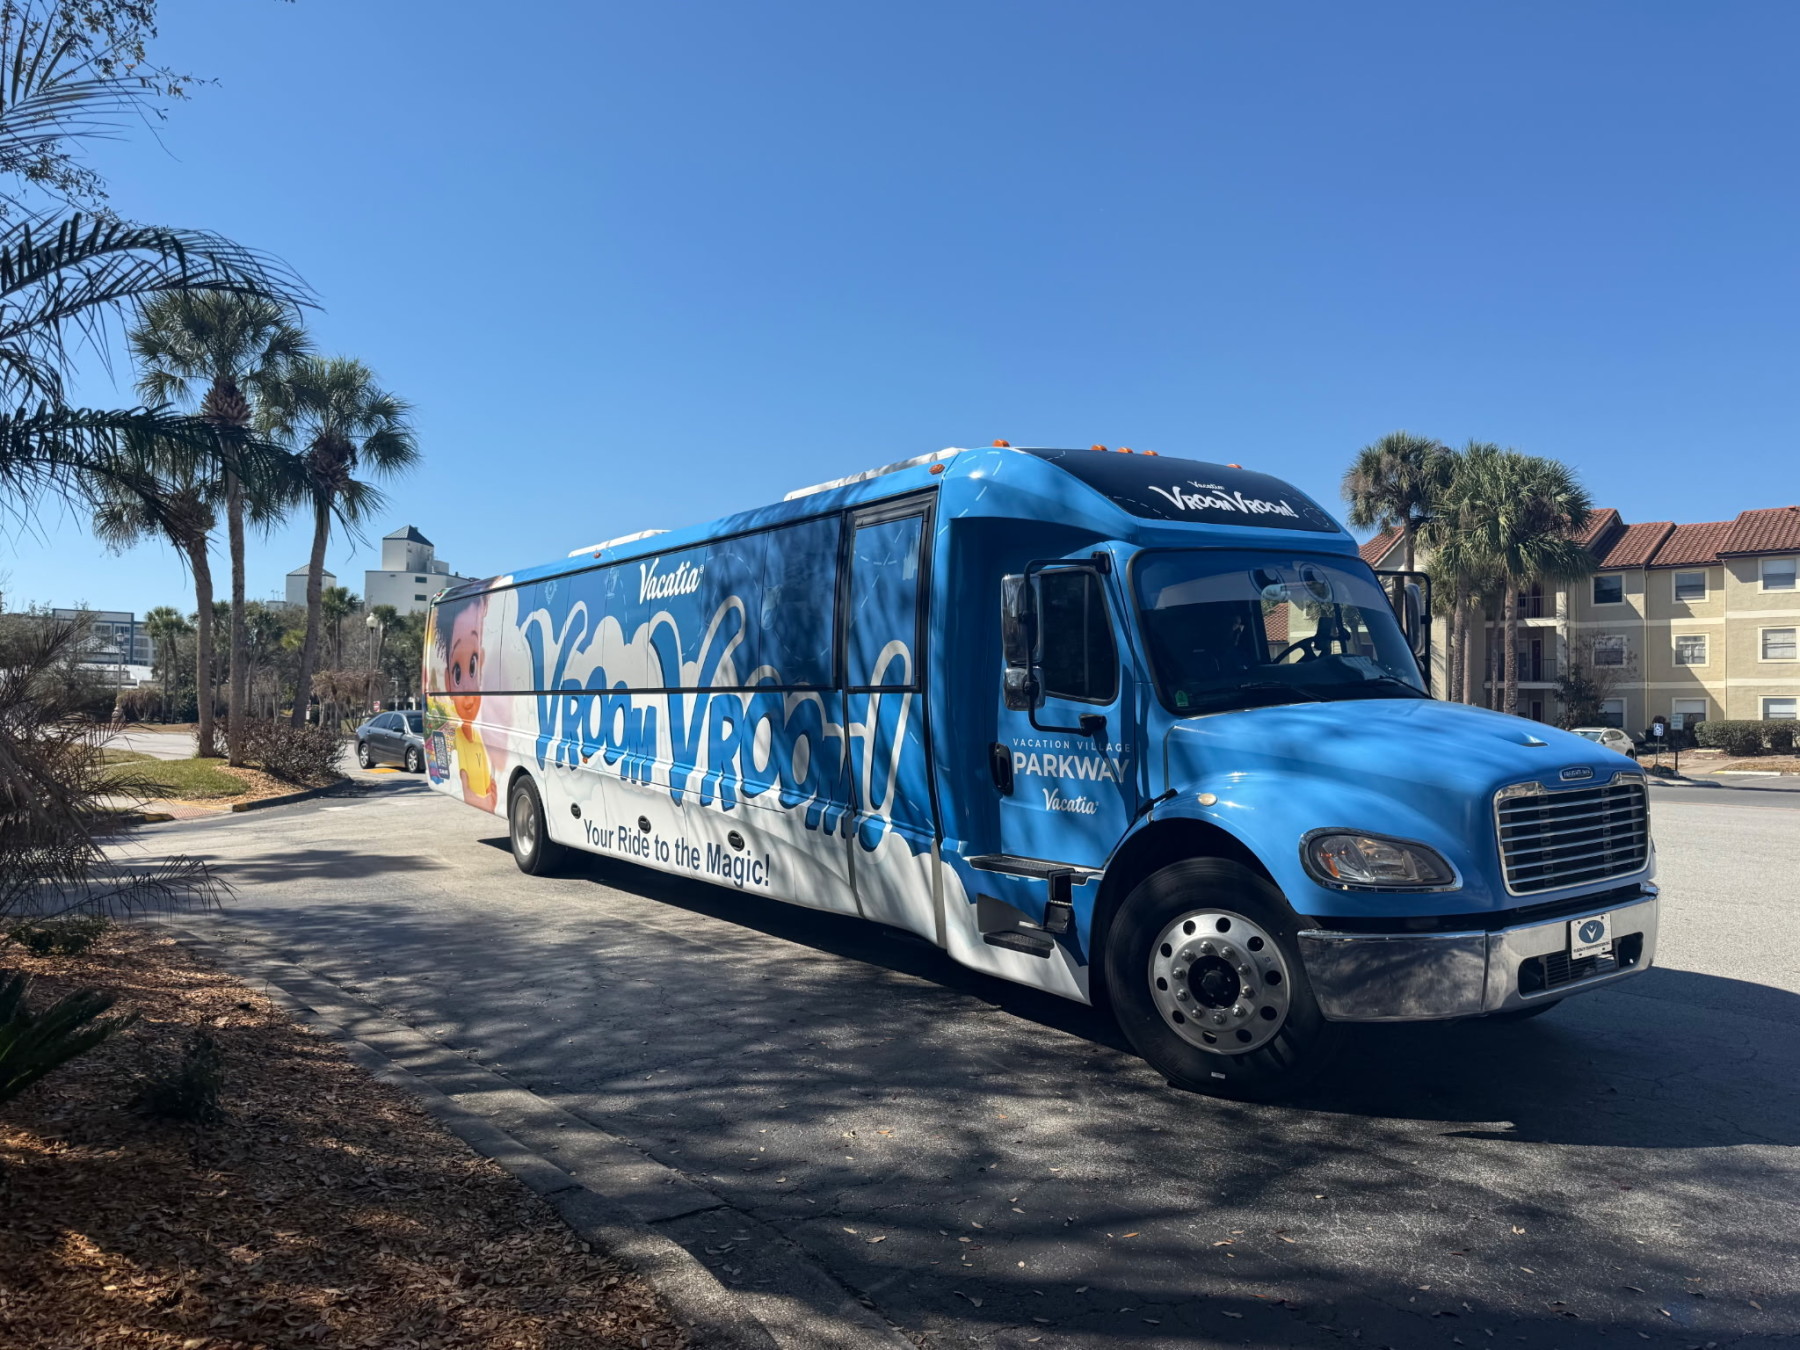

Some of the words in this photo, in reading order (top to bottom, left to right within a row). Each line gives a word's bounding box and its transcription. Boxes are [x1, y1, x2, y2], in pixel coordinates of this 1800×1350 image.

[1012, 737, 1070, 750] VACATION
[1077, 740, 1131, 753] VILLAGE
[1013, 751, 1130, 784] PARKWAY
[583, 818, 615, 849] Your
[618, 825, 650, 859] Ride
[654, 834, 670, 863] to
[674, 837, 701, 871] the
[706, 842, 770, 889] Magic!
